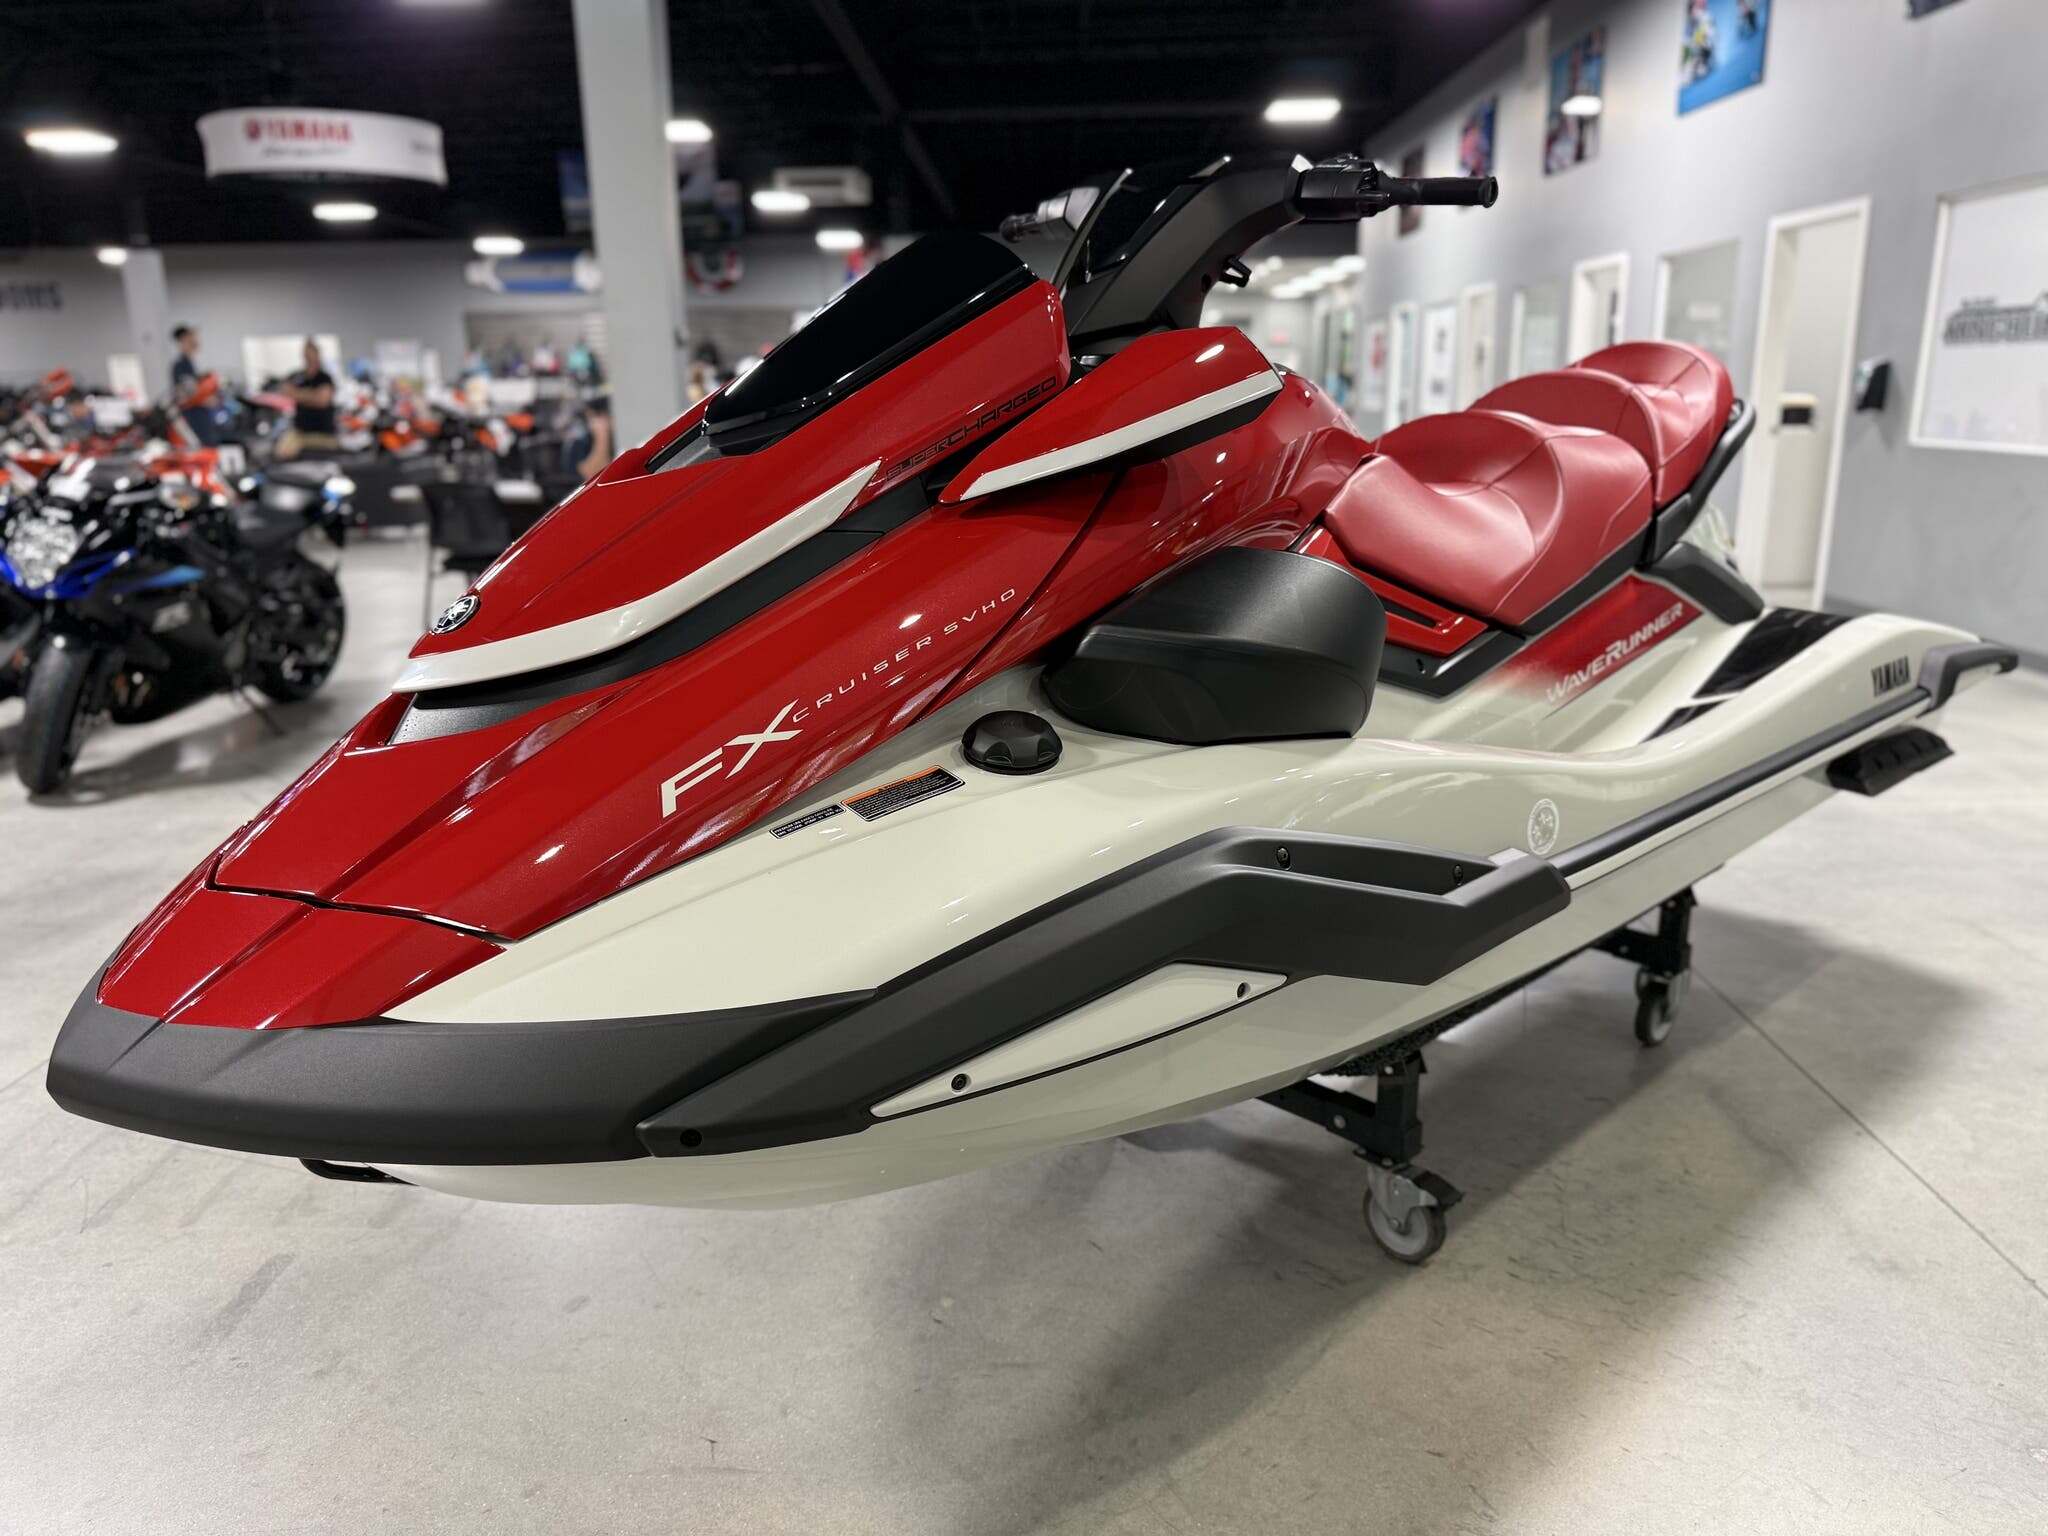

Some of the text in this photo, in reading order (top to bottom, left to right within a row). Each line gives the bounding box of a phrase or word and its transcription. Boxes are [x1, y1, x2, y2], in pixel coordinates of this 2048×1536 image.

[885, 376, 1056, 481] SUPERCHARGED
[660, 698, 803, 819] FX
[792, 636, 932, 723] CRUISER
[943, 588, 1016, 636] SVHO
[1871, 655, 1911, 697] YAMAHA
